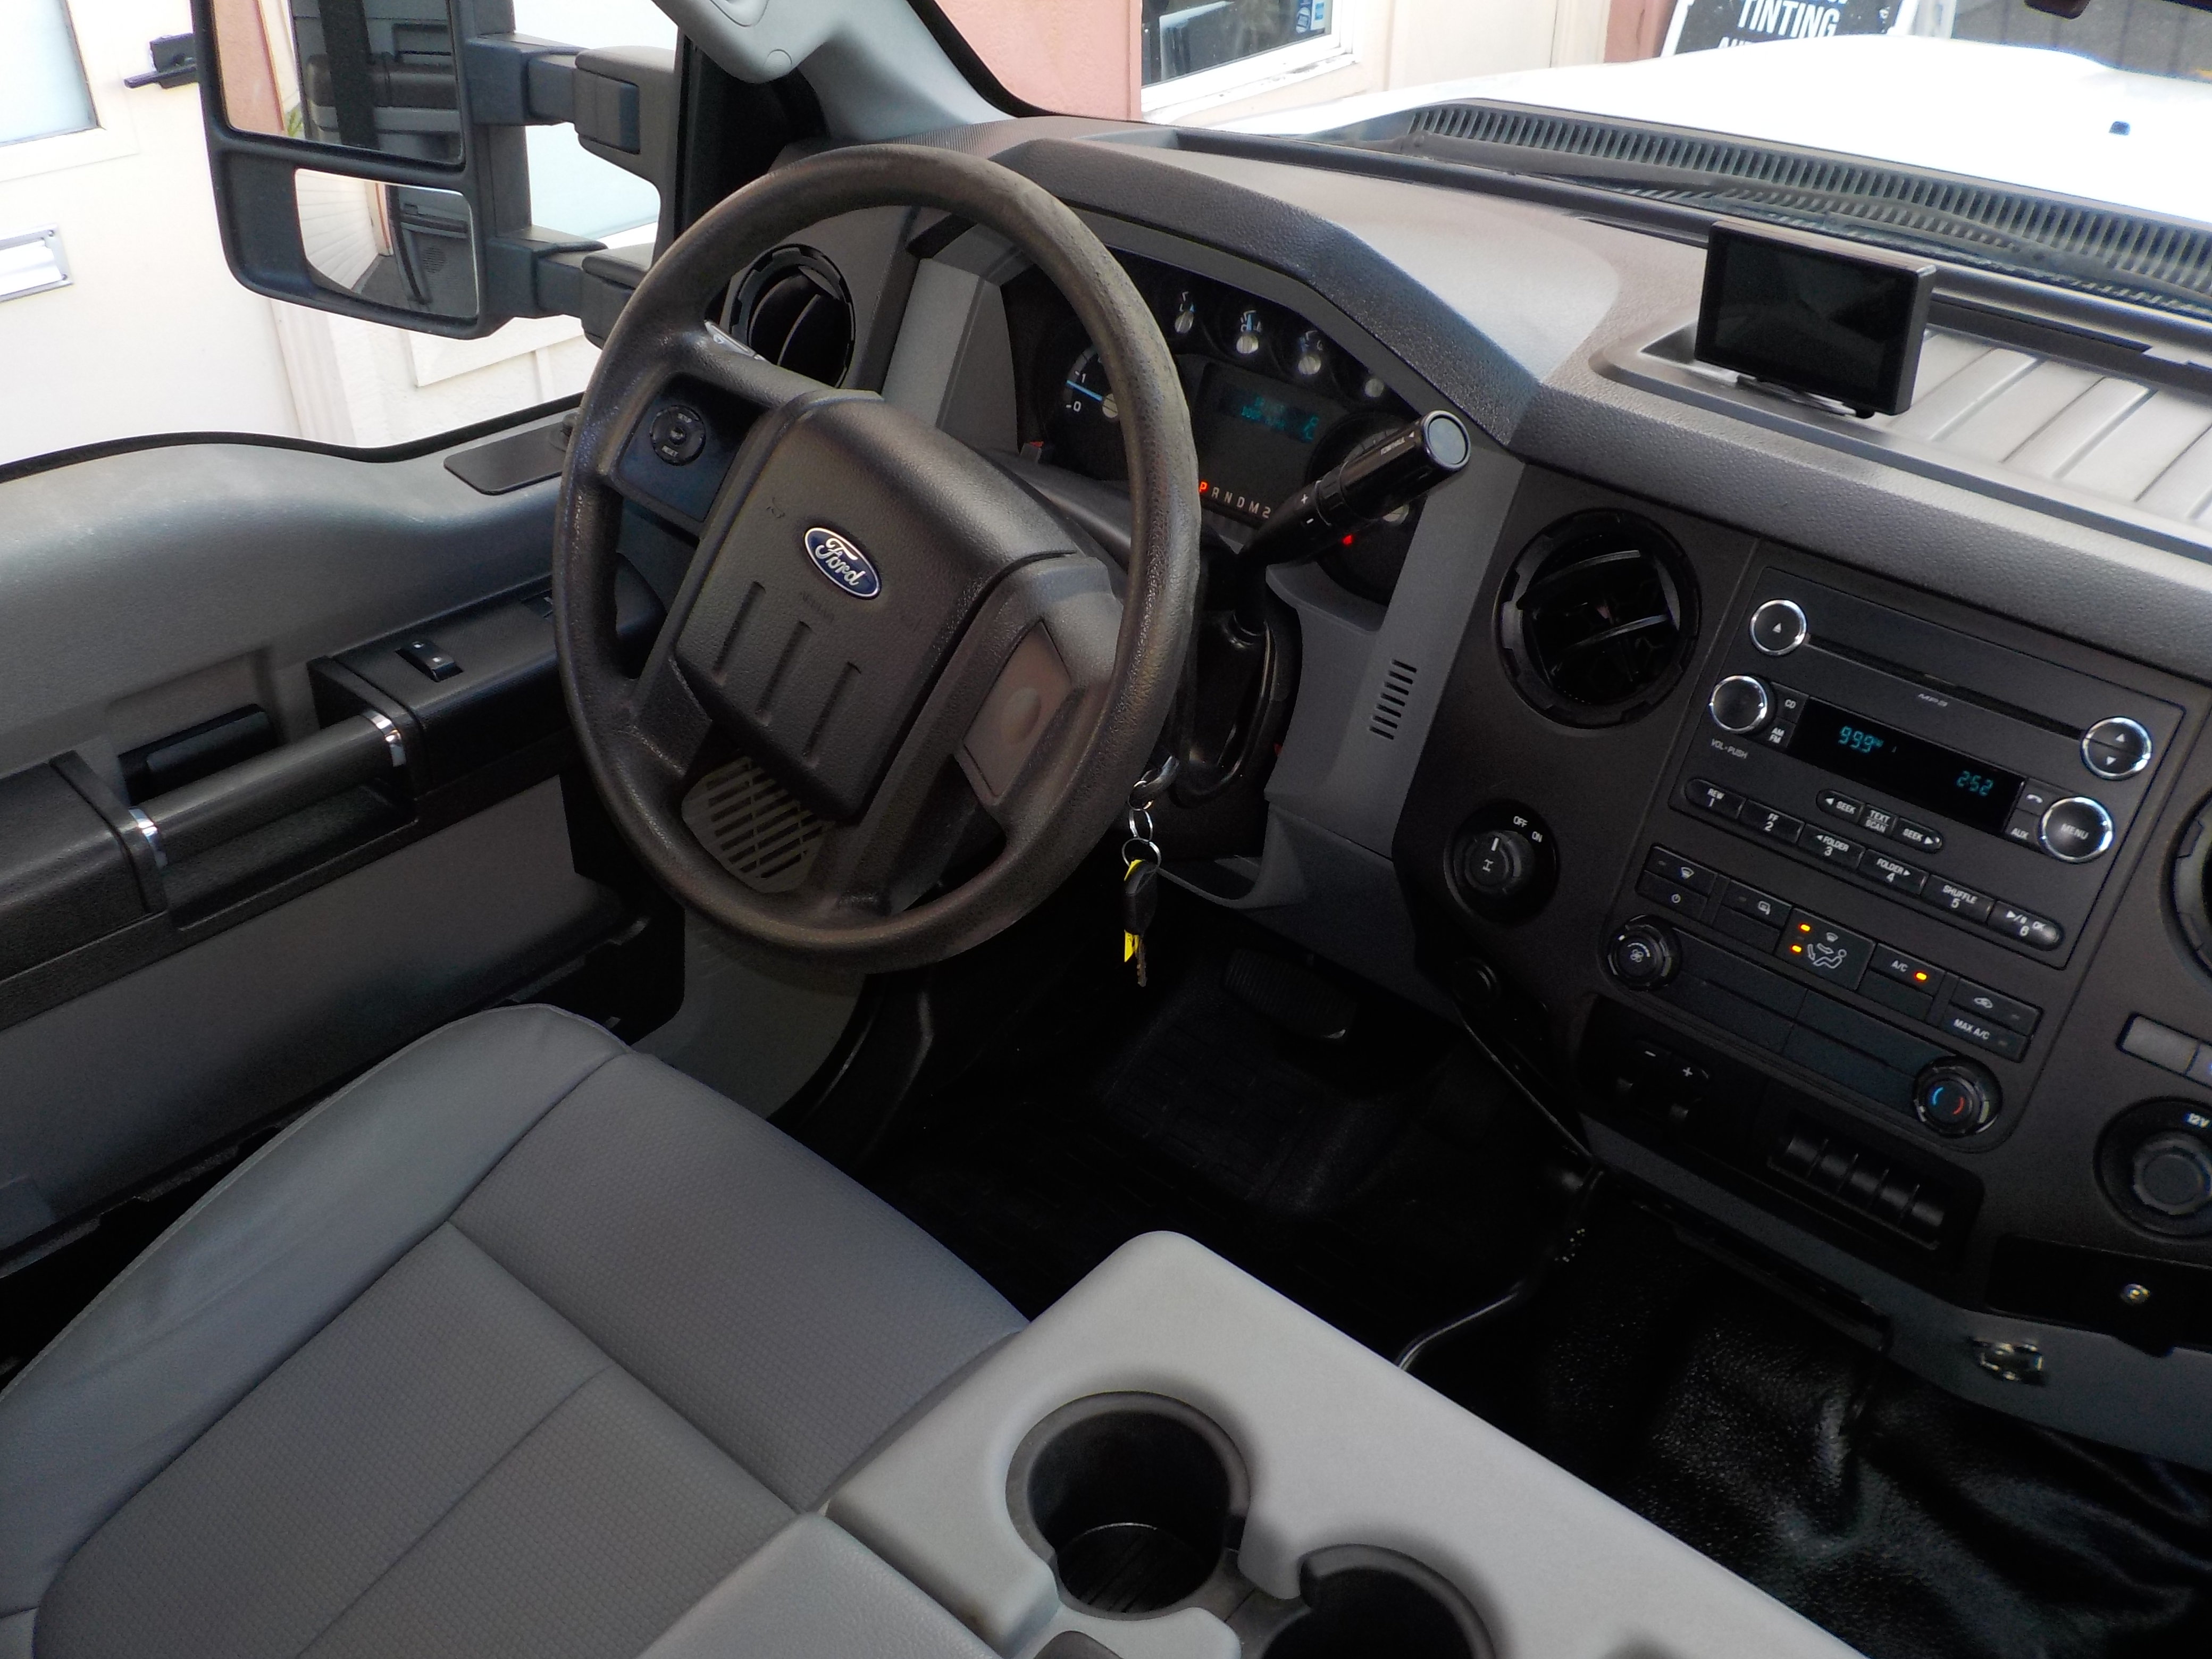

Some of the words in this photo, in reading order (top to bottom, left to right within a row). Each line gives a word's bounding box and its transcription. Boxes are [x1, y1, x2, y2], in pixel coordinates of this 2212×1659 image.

[1737, 0, 1840, 38] TINTING
[1199, 481, 1208, 493] P
[1211, 487, 1220, 499] R
[1224, 491, 1233, 504] N
[1236, 496, 1245, 508] D
[1249, 500, 1260, 514] M
[1262, 506, 1271, 519] 2
[815, 538, 867, 585] Ford
[1784, 699, 1796, 709] CD
[1769, 734, 1782, 744] FM
[1771, 727, 1785, 738] AM
[1707, 787, 1725, 800] REW
[1707, 798, 1714, 807] 1
[1836, 800, 1856, 815] SEEK
[1513, 816, 1529, 827] OFF
[1767, 812, 1780, 822] FF
[1869, 809, 1891, 823] TEXT
[1764, 822, 1774, 832] 2
[1864, 819, 1887, 833] SCAN
[2060, 823, 2090, 840] MENU
[1531, 831, 1543, 843] ON
[1902, 828, 1924, 842] SEEK
[2010, 827, 2029, 840] AUX
[1822, 835, 1850, 852] FOLDER
[1824, 846, 1832, 857] 3
[1876, 858, 1905, 875] FOLDER
[1886, 872, 1895, 883] 4
[1942, 884, 1979, 904] SHUFFLE
[1951, 898, 1960, 909] 5
[2020, 926, 2030, 937] 6
[1891, 960, 1908, 973] A/C
[1953, 1018, 1974, 1034] MAX
[1973, 1027, 1991, 1040] A/C
